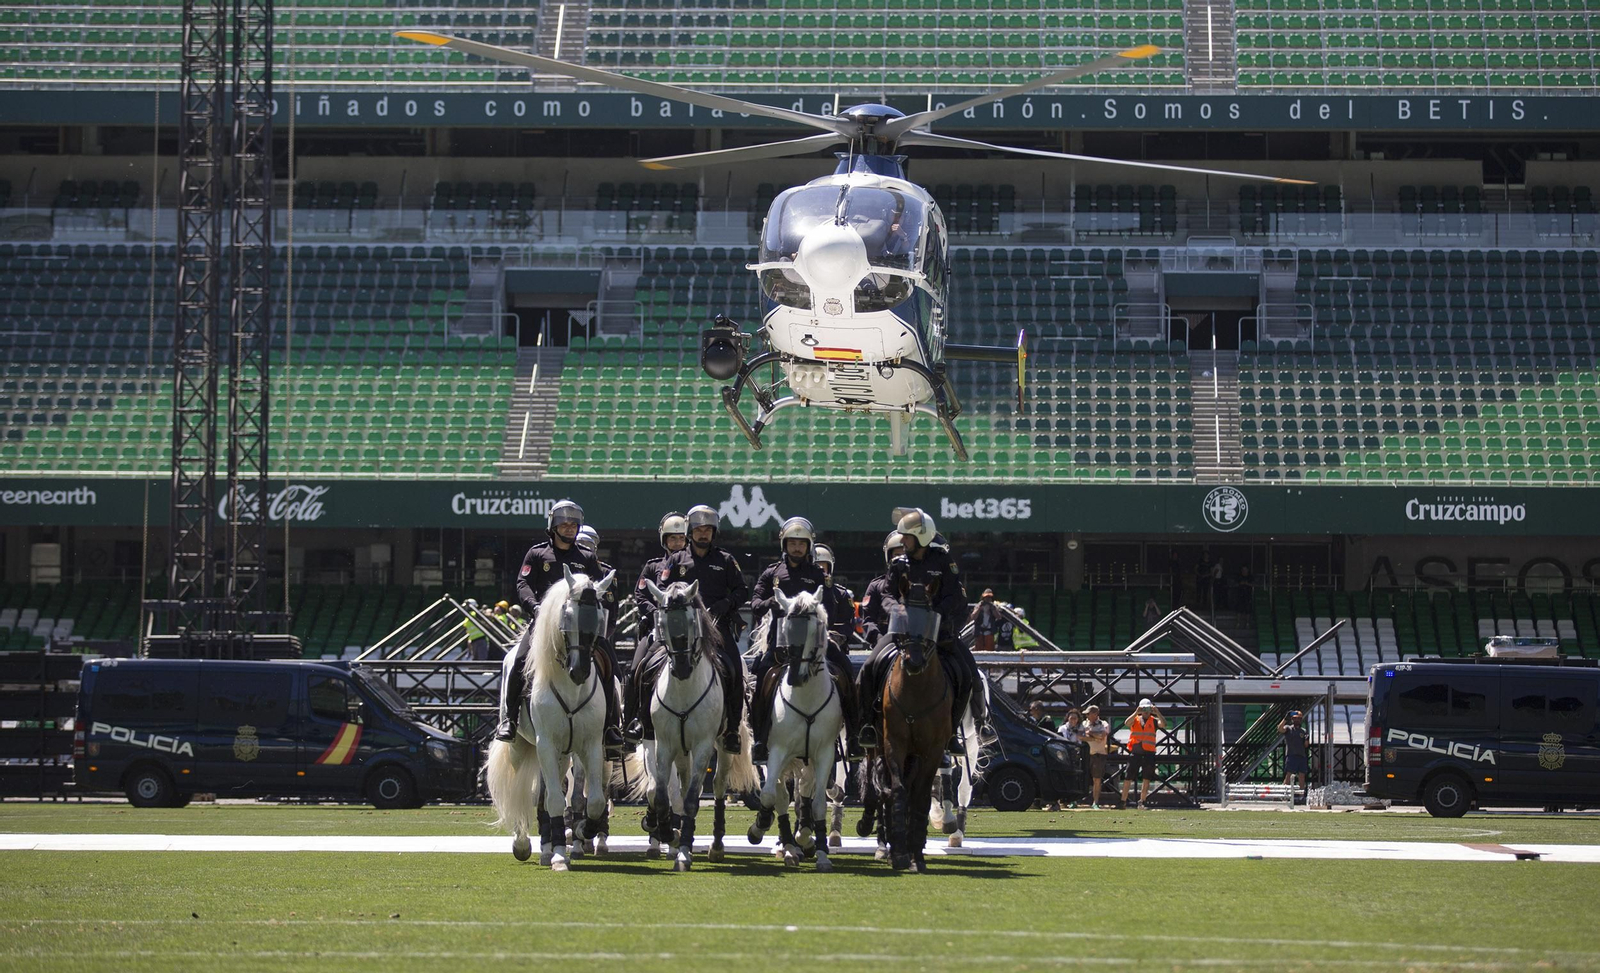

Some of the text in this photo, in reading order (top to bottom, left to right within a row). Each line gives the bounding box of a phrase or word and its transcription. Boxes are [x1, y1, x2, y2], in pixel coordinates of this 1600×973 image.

[485, 99, 591, 117] como
[1104, 98, 1240, 119] Somos
[1289, 99, 1353, 120] del
[1398, 99, 1548, 120] BETIS.
[451, 491, 569, 518] Cruzcamp
[940, 497, 1031, 519] bet365
[1205, 488, 1246, 510] ALFA ROMEO
[1405, 497, 1526, 525] Cruzcampo
[91, 721, 194, 757] POLICÍA
[1386, 728, 1496, 765] POLICÍA
